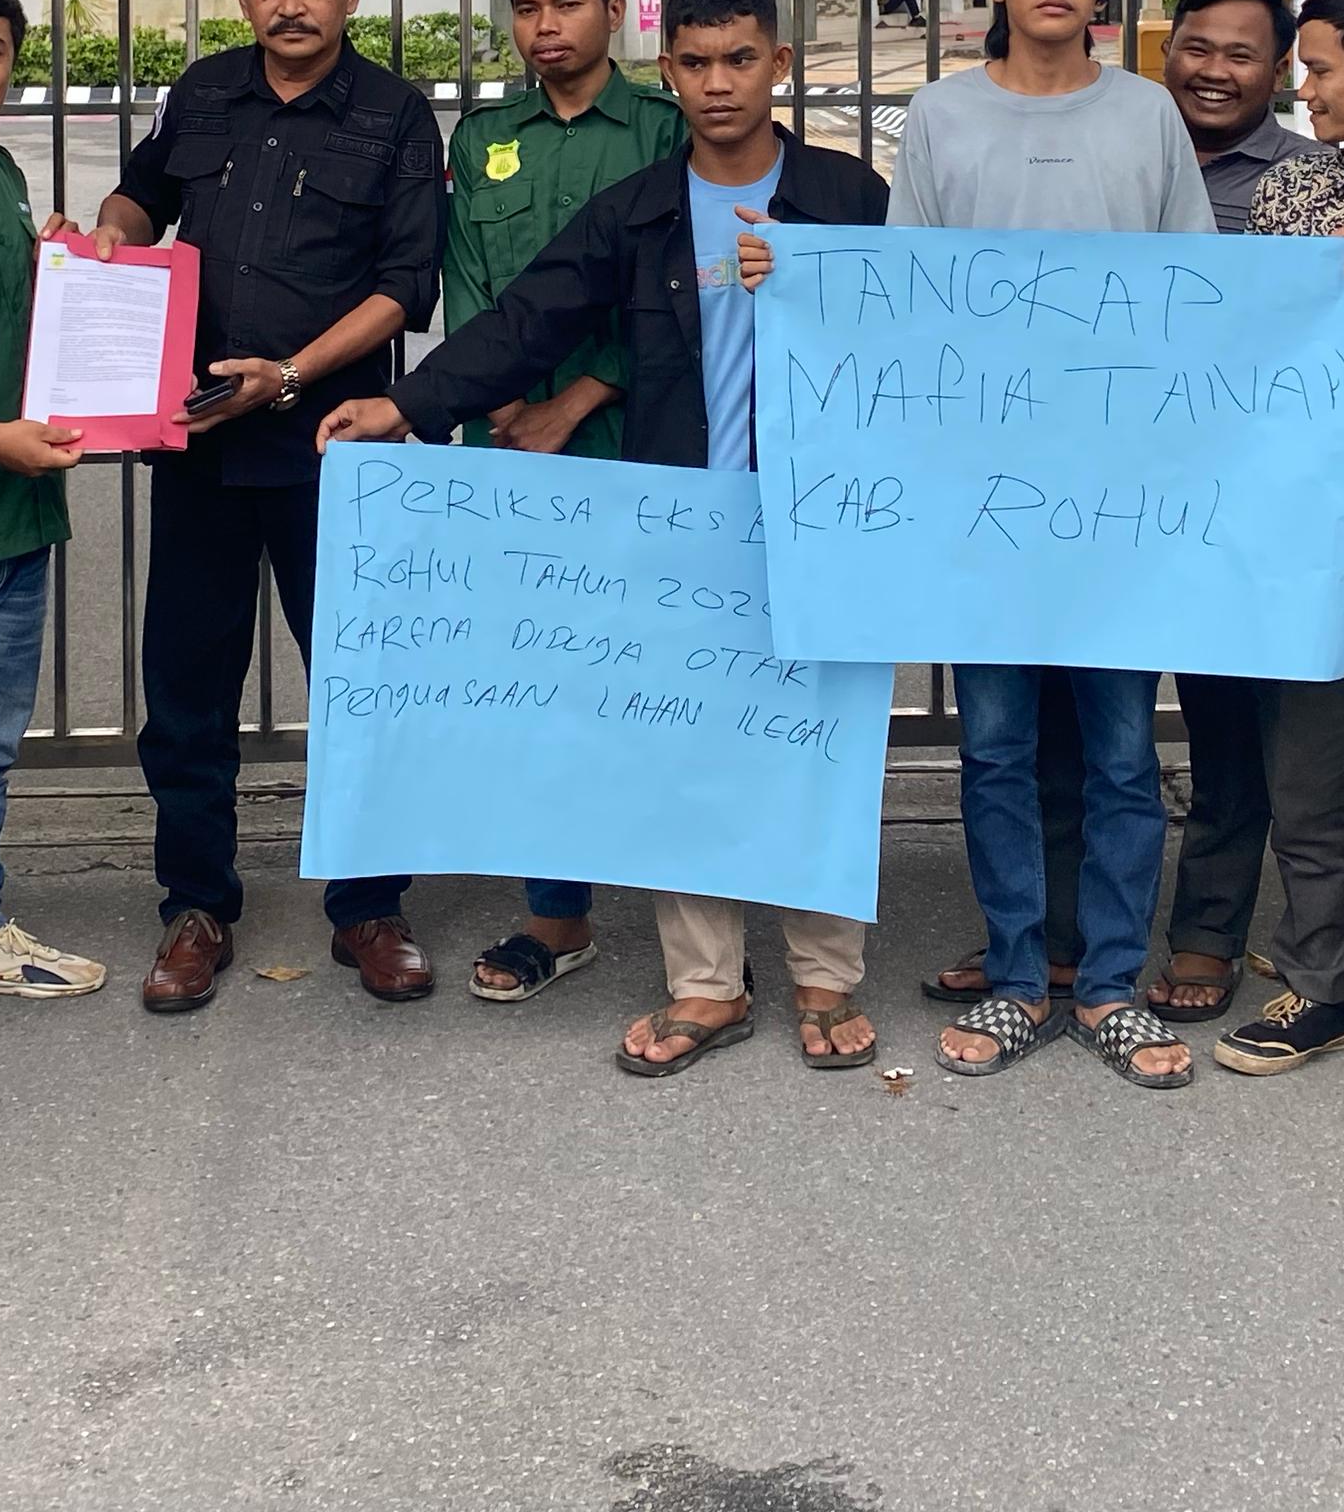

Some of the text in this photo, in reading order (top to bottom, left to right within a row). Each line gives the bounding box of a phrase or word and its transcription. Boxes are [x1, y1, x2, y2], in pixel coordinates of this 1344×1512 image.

[792, 248, 1224, 342] TANGKAP
[685, 648, 809, 689] OTAK
[597, 686, 703, 727] LAHAN
